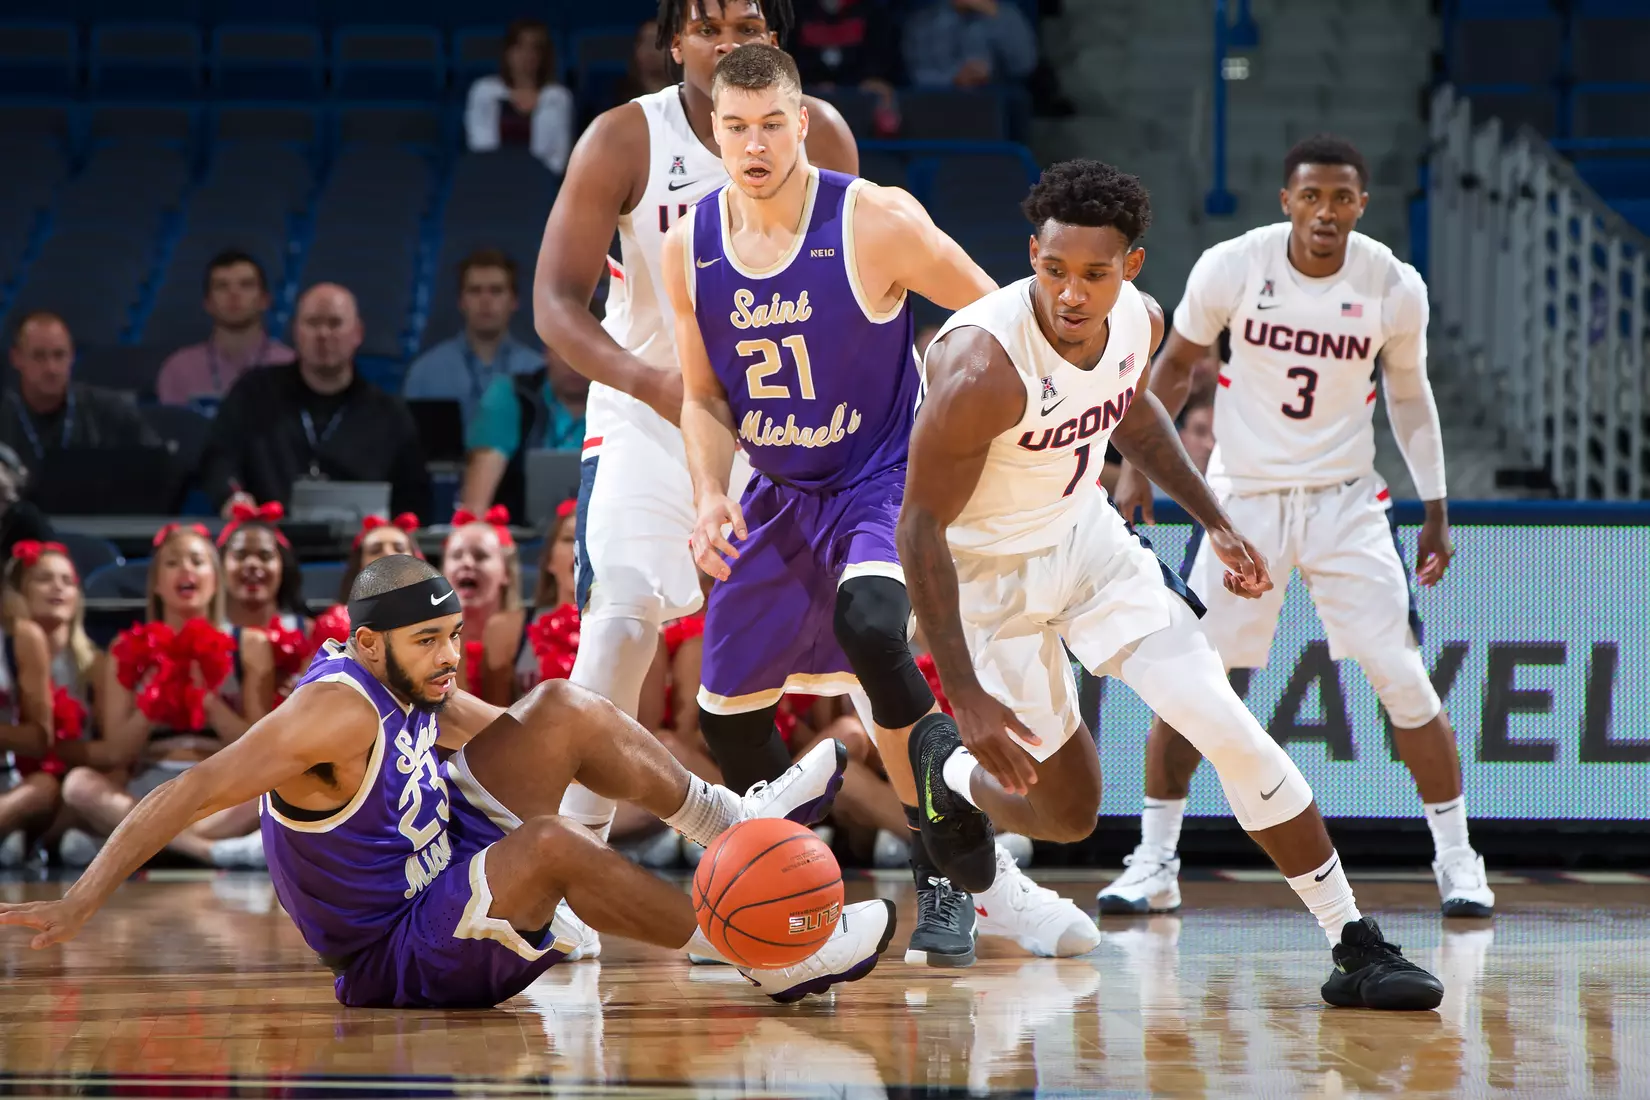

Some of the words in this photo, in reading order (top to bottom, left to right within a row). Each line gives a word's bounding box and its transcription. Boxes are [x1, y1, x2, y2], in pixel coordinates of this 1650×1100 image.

[730, 288, 812, 329] Saint
[1244, 318, 1372, 360] UCONN
[735, 334, 816, 400] 21
[1281, 366, 1319, 420] 3
[738, 401, 861, 448] Michael's
[1062, 443, 1090, 498] 1
[789, 901, 840, 935] ELITE
